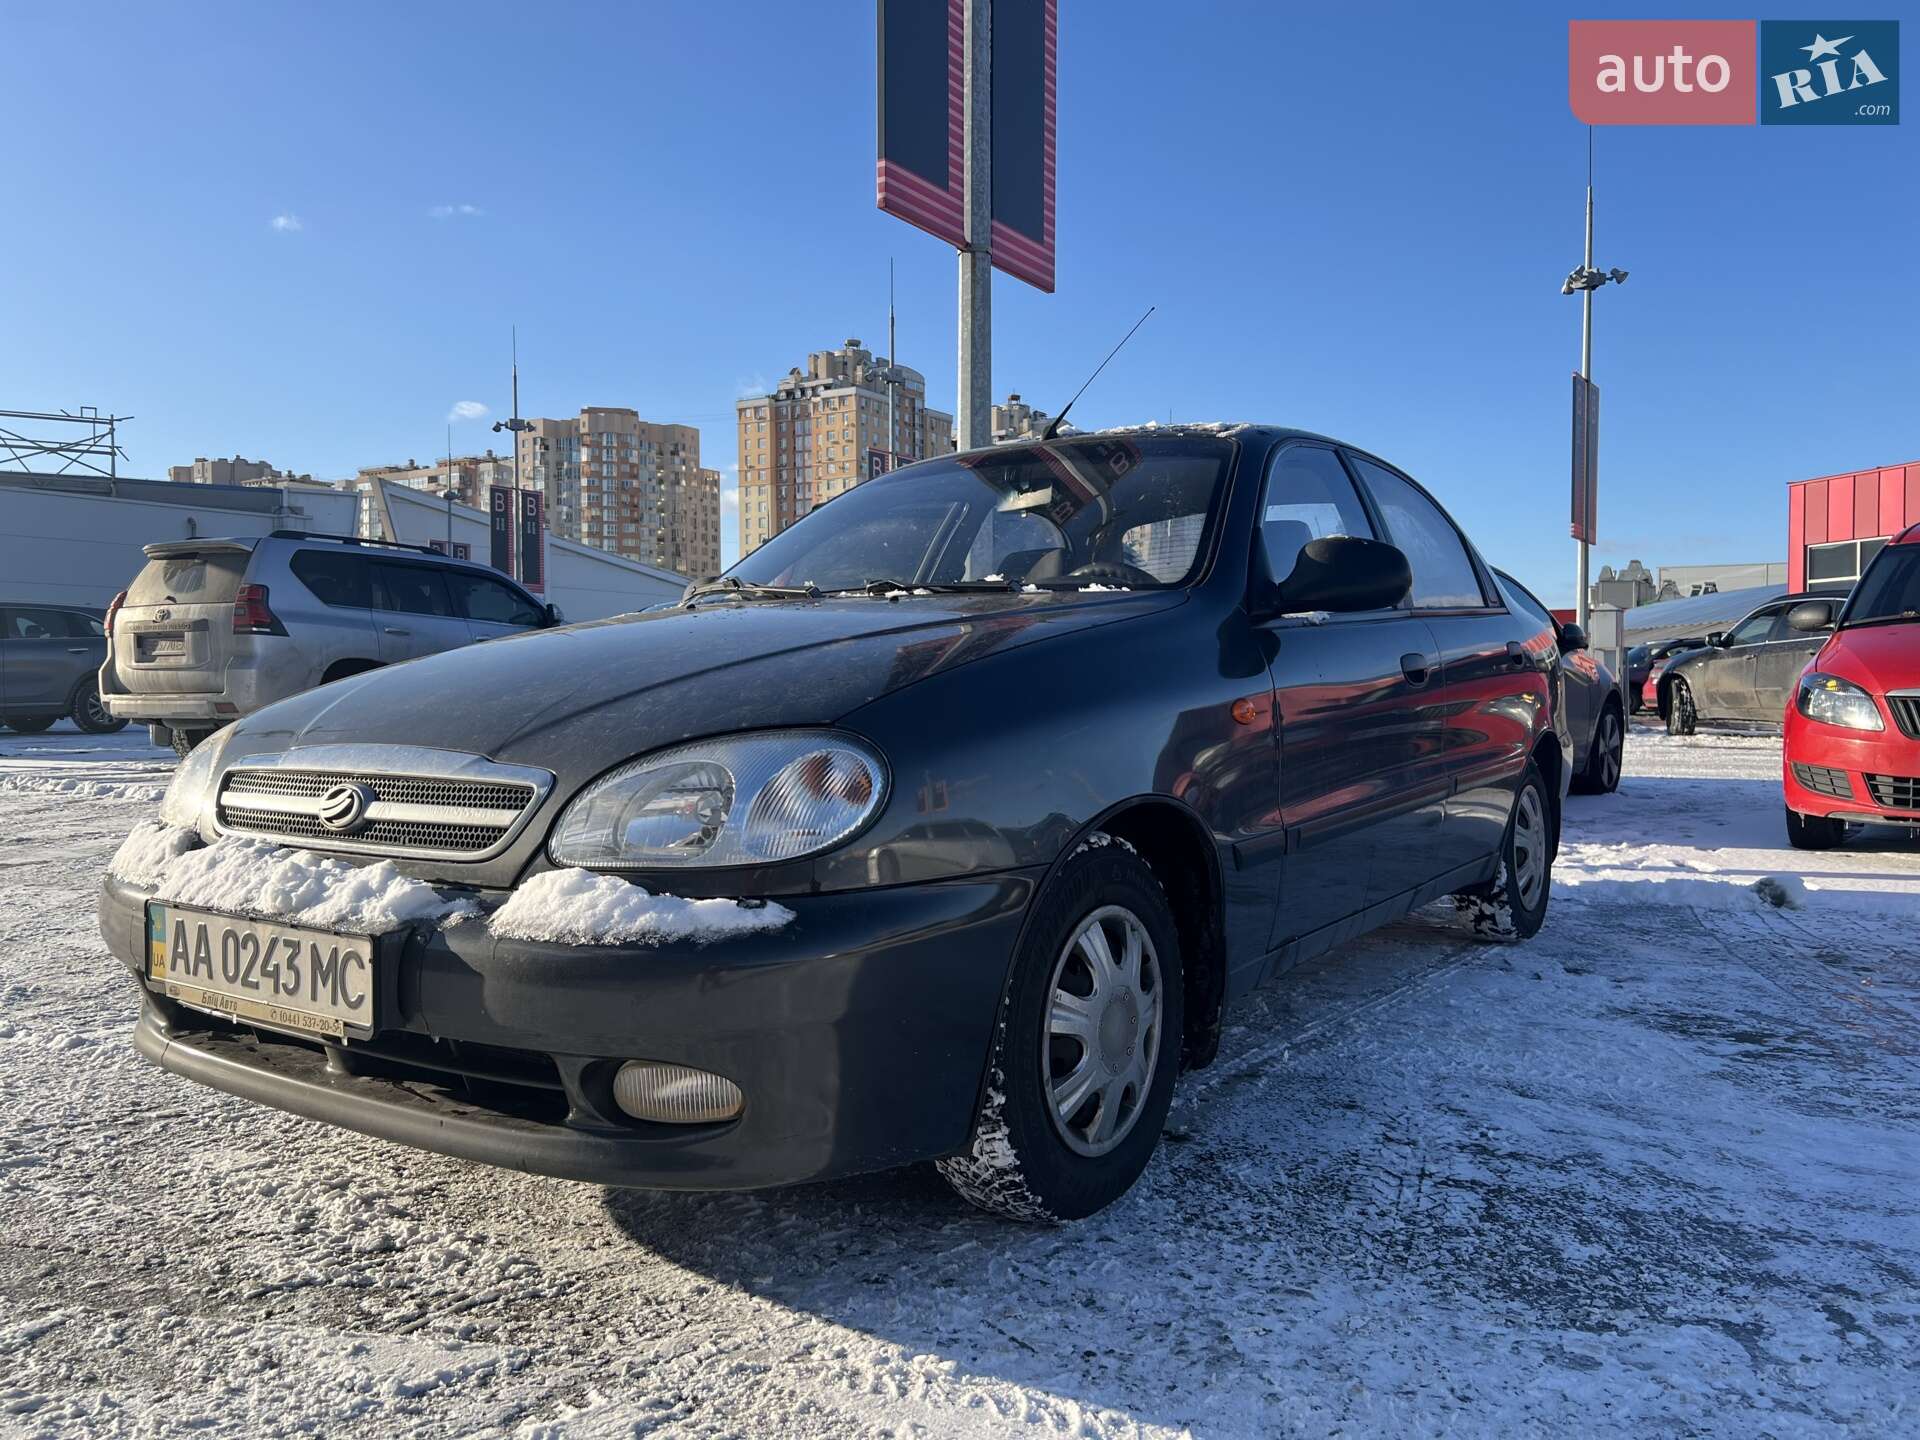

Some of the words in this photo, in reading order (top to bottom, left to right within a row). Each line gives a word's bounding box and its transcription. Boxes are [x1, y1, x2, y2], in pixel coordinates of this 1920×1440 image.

[495, 492, 505, 512] B
[527, 496, 537, 516] B
[152, 952, 166, 969] UA
[169, 917, 214, 981] AA
[221, 926, 301, 997] 0243
[309, 942, 365, 1010] MC
